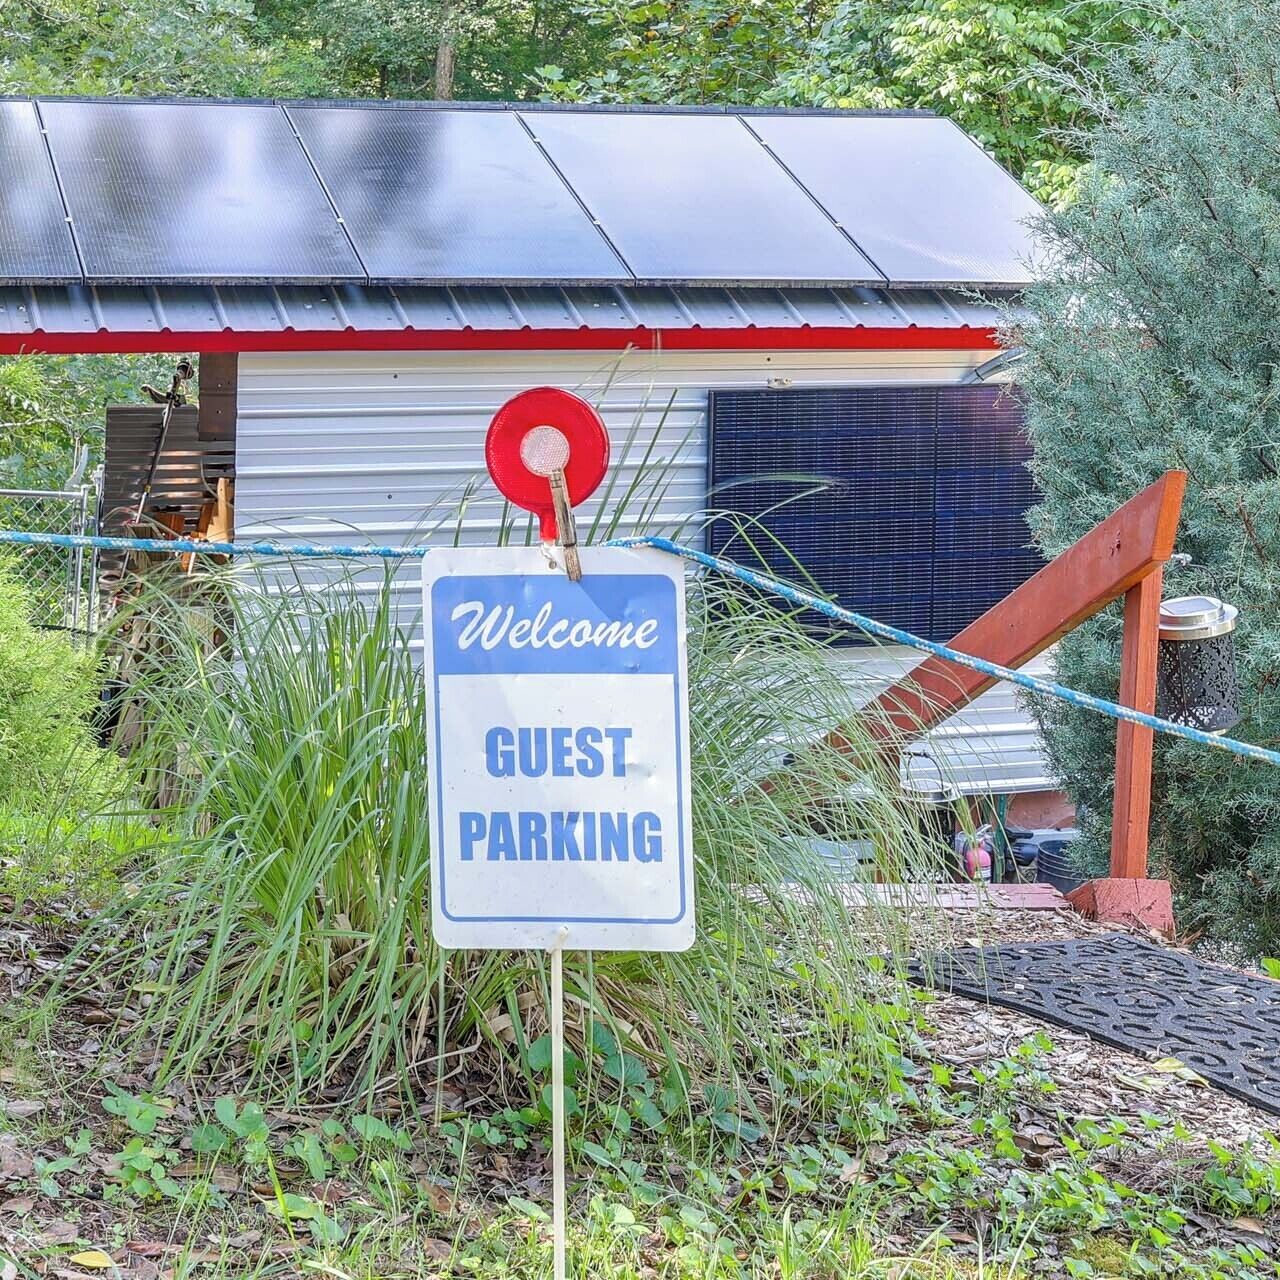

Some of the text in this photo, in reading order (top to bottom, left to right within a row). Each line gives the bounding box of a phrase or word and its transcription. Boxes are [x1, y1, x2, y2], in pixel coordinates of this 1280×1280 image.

[451, 600, 658, 651] Welcome
[485, 725, 632, 779] GUEST
[459, 810, 663, 863] PARKING
